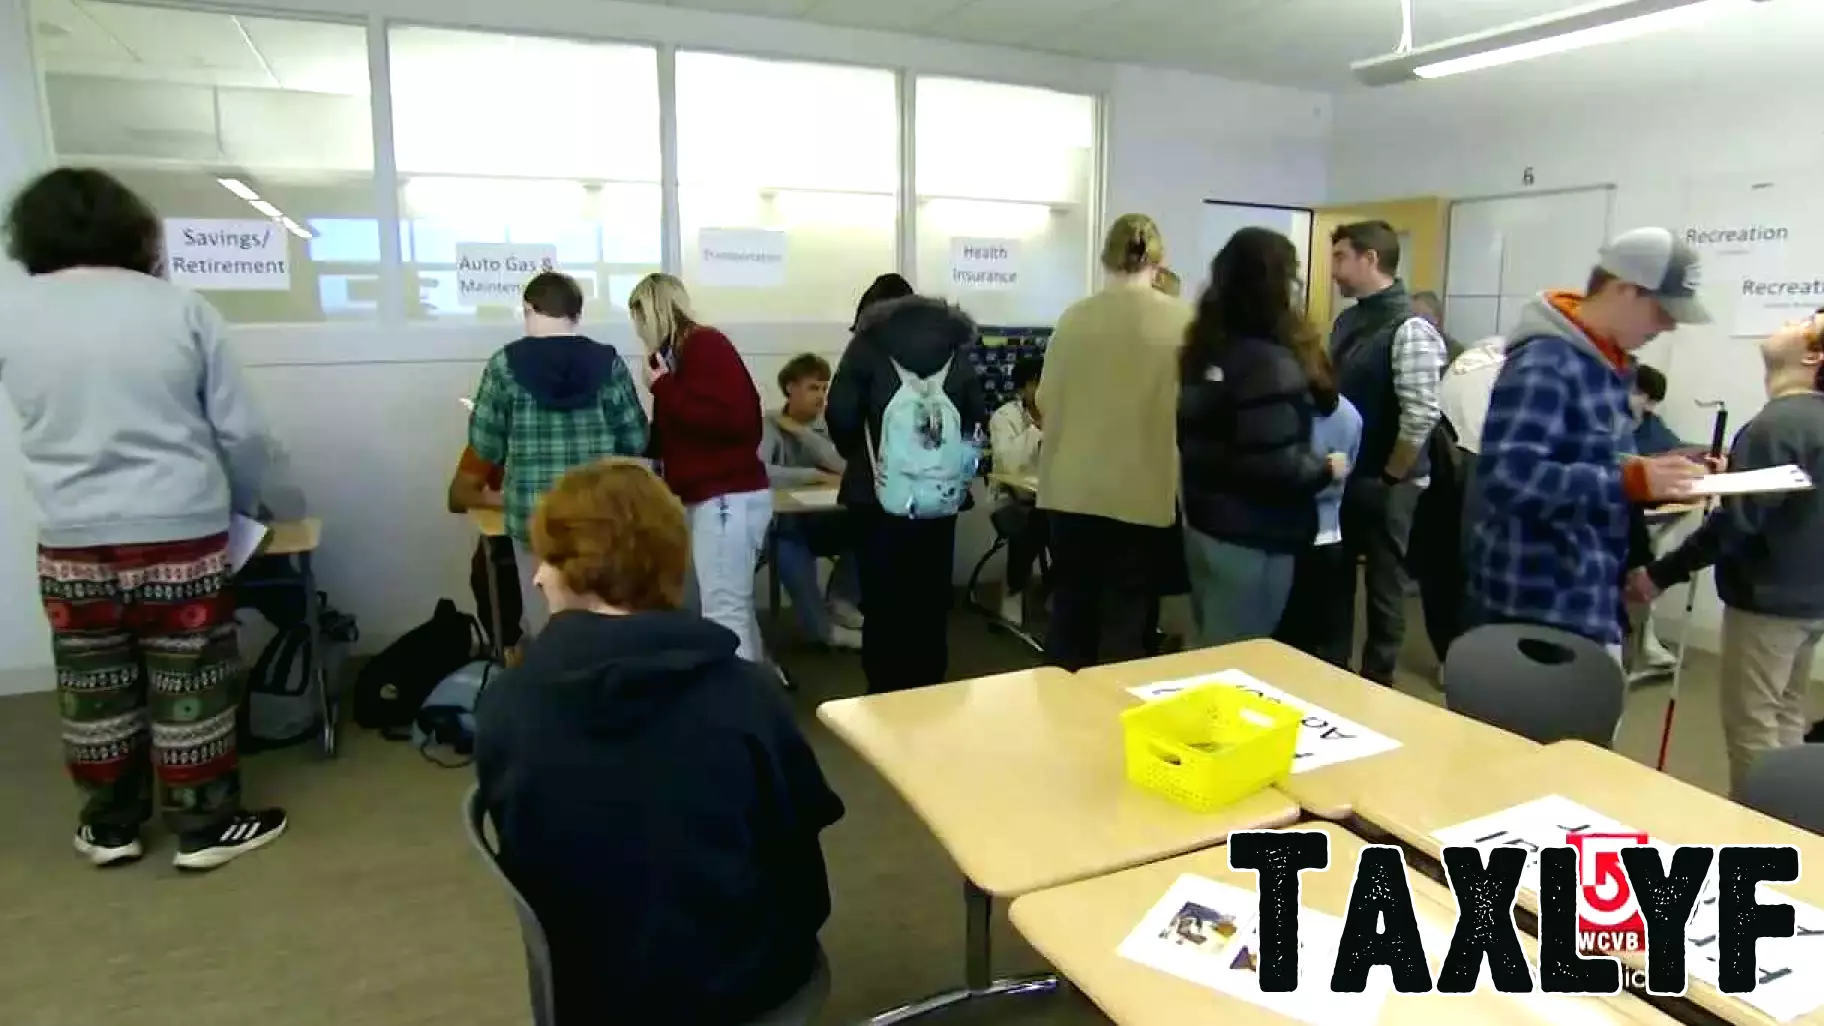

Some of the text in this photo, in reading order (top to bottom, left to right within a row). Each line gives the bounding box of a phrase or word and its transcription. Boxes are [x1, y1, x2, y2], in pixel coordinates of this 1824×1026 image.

[1523, 166, 1534, 186] 6
[183, 228, 270, 249] Savings/
[1686, 227, 1788, 243] Recreation
[964, 245, 1007, 259] Health
[173, 256, 284, 273] Retirement
[460, 257, 500, 271] Auto
[505, 257, 536, 271] Gas
[953, 267, 1017, 283] Insurance
[460, 279, 524, 293] Mainten
